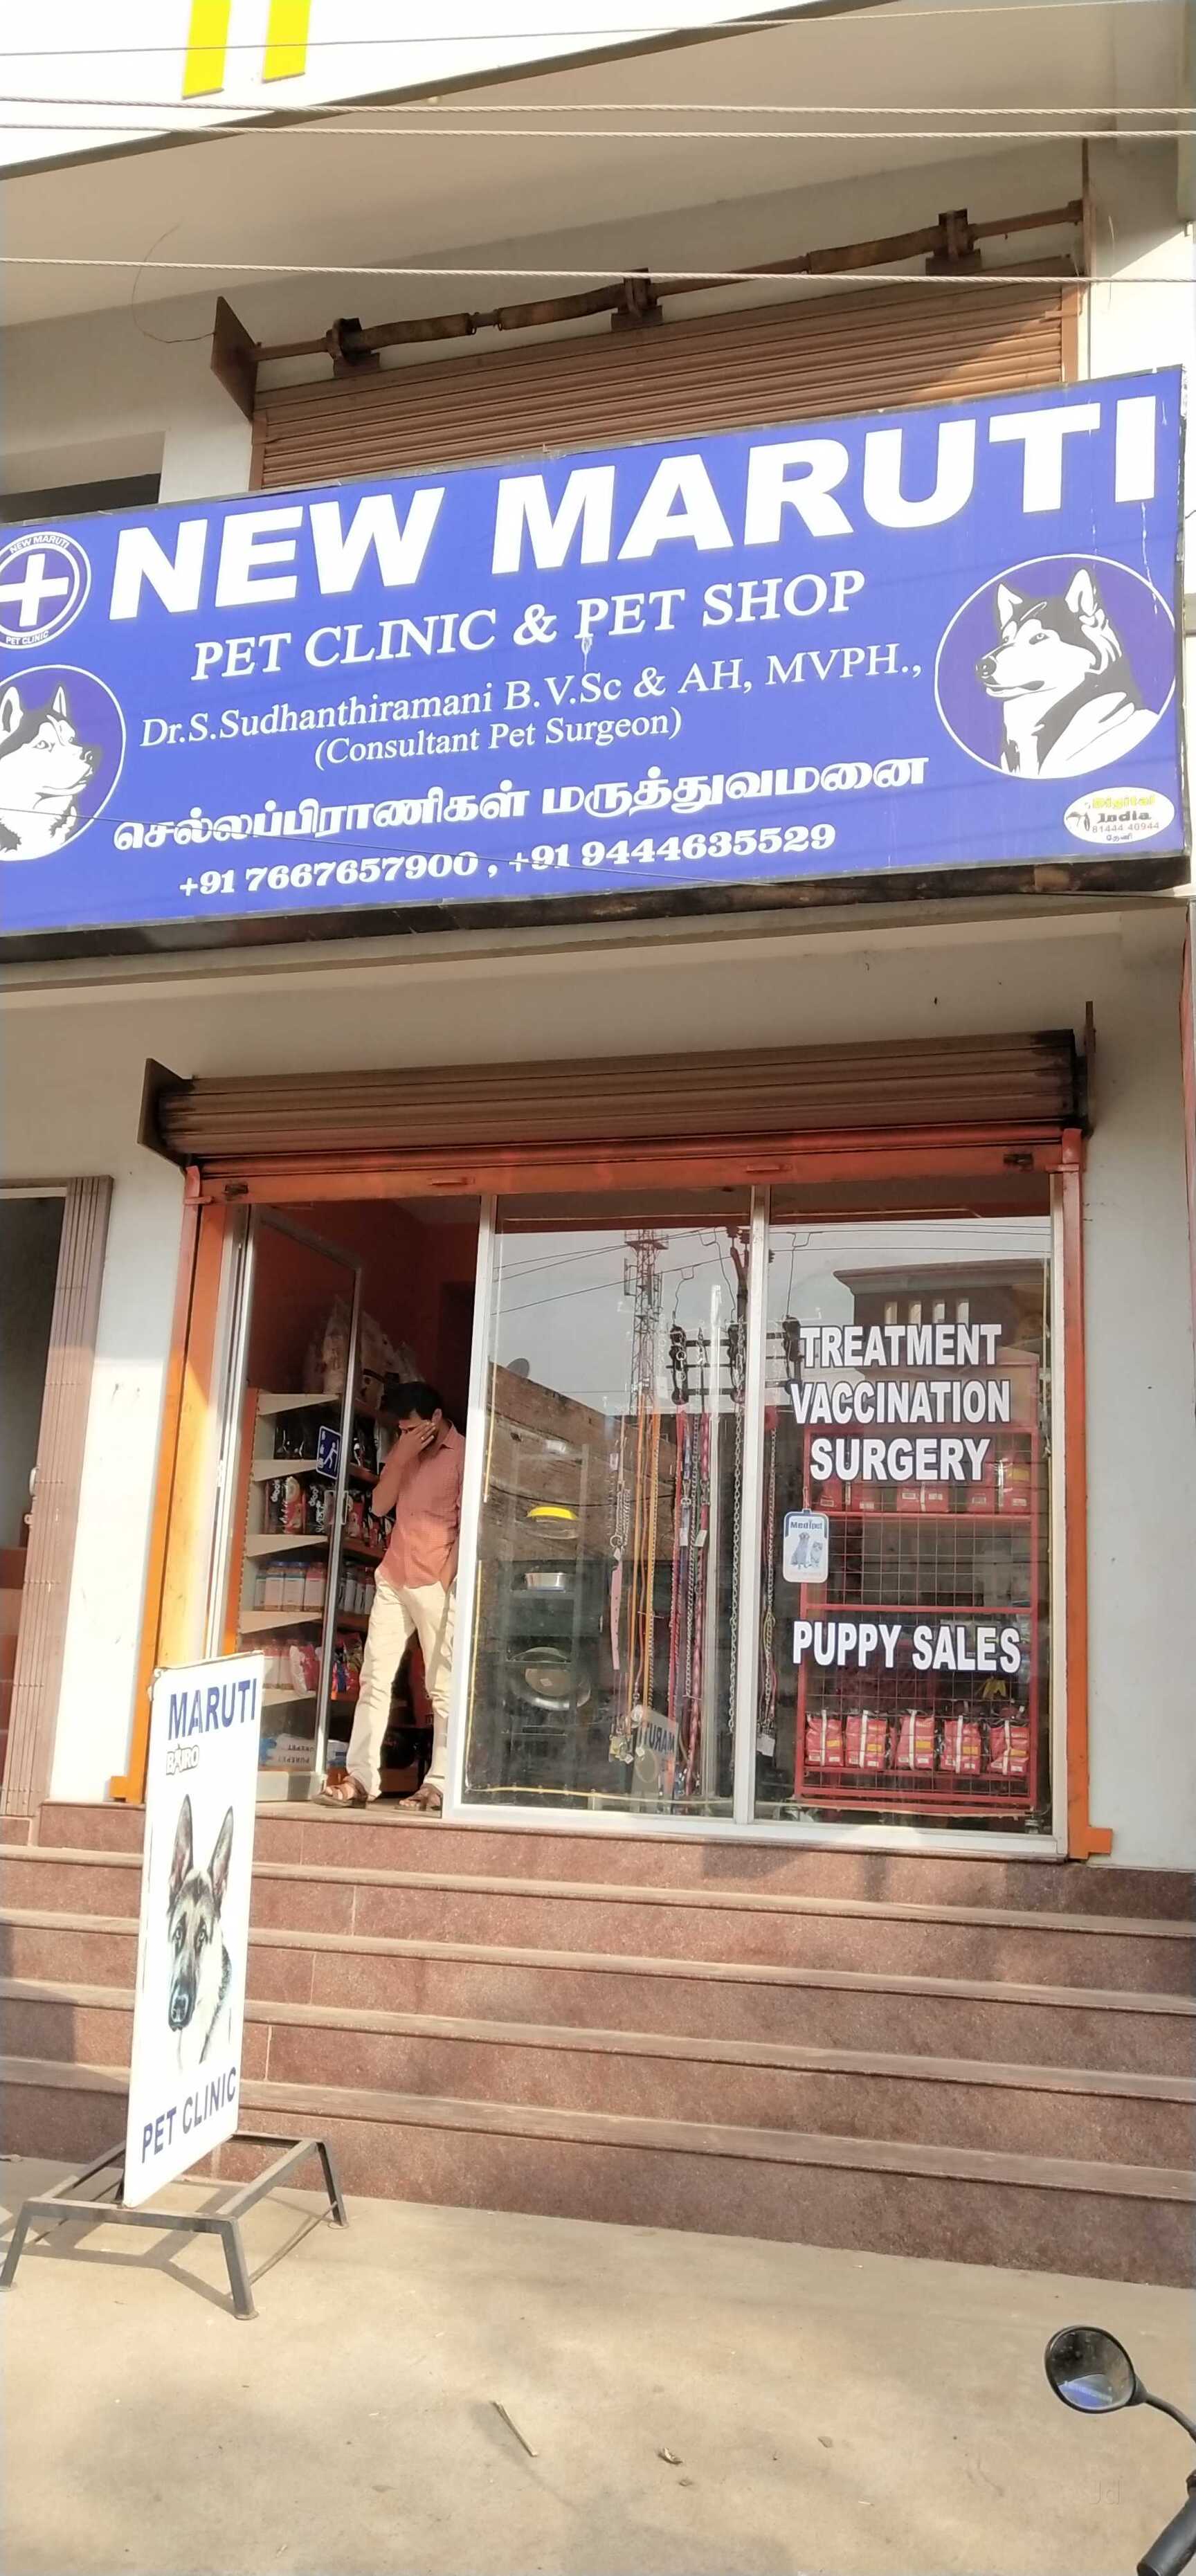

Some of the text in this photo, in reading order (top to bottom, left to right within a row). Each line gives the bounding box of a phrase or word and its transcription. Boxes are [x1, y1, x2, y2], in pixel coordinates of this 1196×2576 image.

[109, 395, 1157, 621] NEW MARUTI
[9, 535, 70, 554] NEW MARUTI
[6, 631, 49, 645] PET CLINIC
[191, 570, 866, 680] PET CLINIC & PET SHOP
[139, 643, 921, 747] Dr.S.Sudhanthiramani B.V.Sc & AH, MVPH.,
[314, 707, 681, 770] (Consultant Pet Surgeon)
[113, 757, 930, 851] செல்லப்பிராணிகள் மருத்துவமனை
[1097, 810, 1152, 824] India
[179, 869, 235, 896] +91
[245, 851, 478, 892] 7667657900
[509, 844, 570, 872] +91
[581, 824, 836, 867] 9444635529
[799, 1323, 1002, 1368] TREATMENT
[790, 1379, 1011, 1424] VACCINATION
[810, 1438, 990, 1481] SURGERY
[790, 1519, 822, 1529] Medipet
[792, 1620, 1021, 1674] PUPPY SALES
[168, 1678, 257, 1741] MARUTI
[142, 2067, 237, 2164] PET CLINIC
